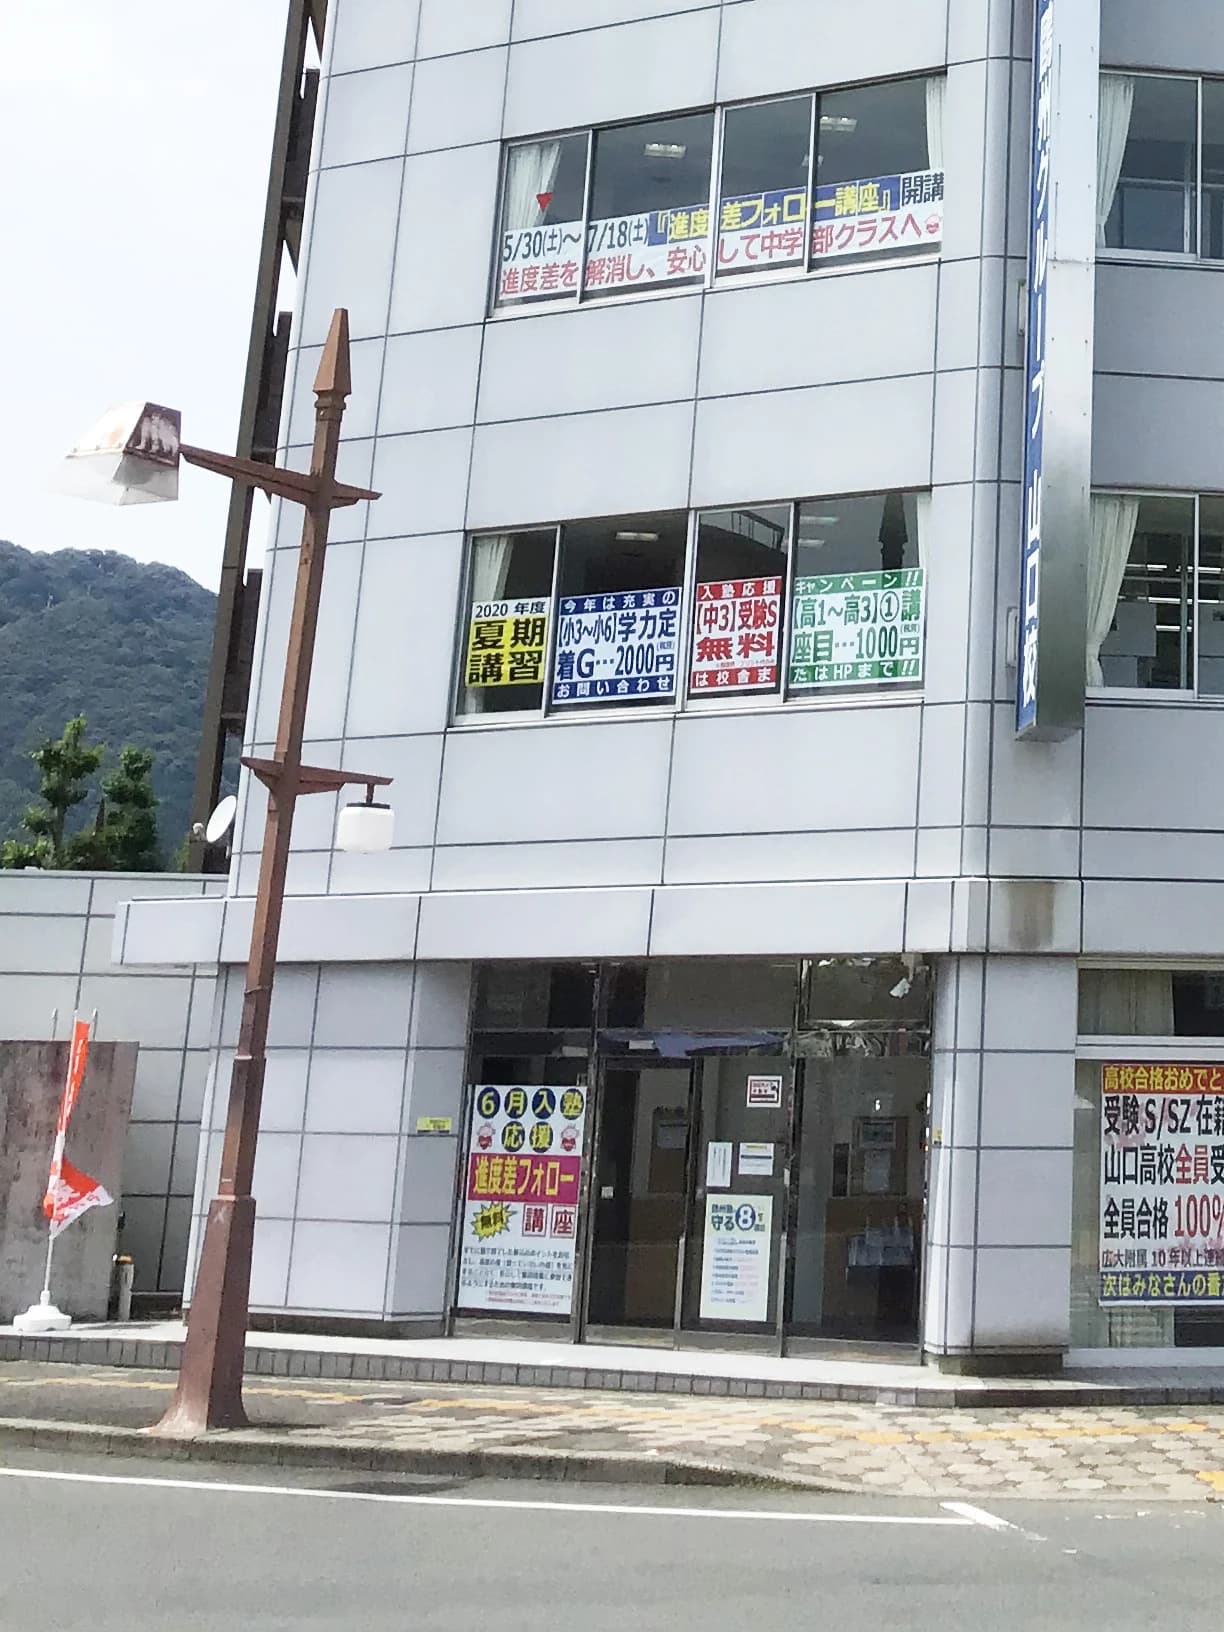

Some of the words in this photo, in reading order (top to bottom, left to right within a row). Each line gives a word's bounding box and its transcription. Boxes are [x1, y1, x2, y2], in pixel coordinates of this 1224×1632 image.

[563, 590, 676, 613] 今年は充実の
[1022, 468, 1042, 709] 山口校
[475, 603, 509, 618] 2020
[514, 601, 547, 615] 年度
[471, 617, 547, 651] 夏期
[695, 631, 776, 662] 無料
[468, 650, 544, 684] 講習
[695, 668, 772, 686] は校舎ま
[556, 677, 671, 699] お問い合わせ
[481, 1089, 582, 1117] 6月入塾
[503, 1123, 551, 1149] 応援
[473, 1155, 576, 1197] 進度差フォロー
[524, 1207, 575, 1235] 講座
[1103, 1196, 1169, 1240] 全員合格
